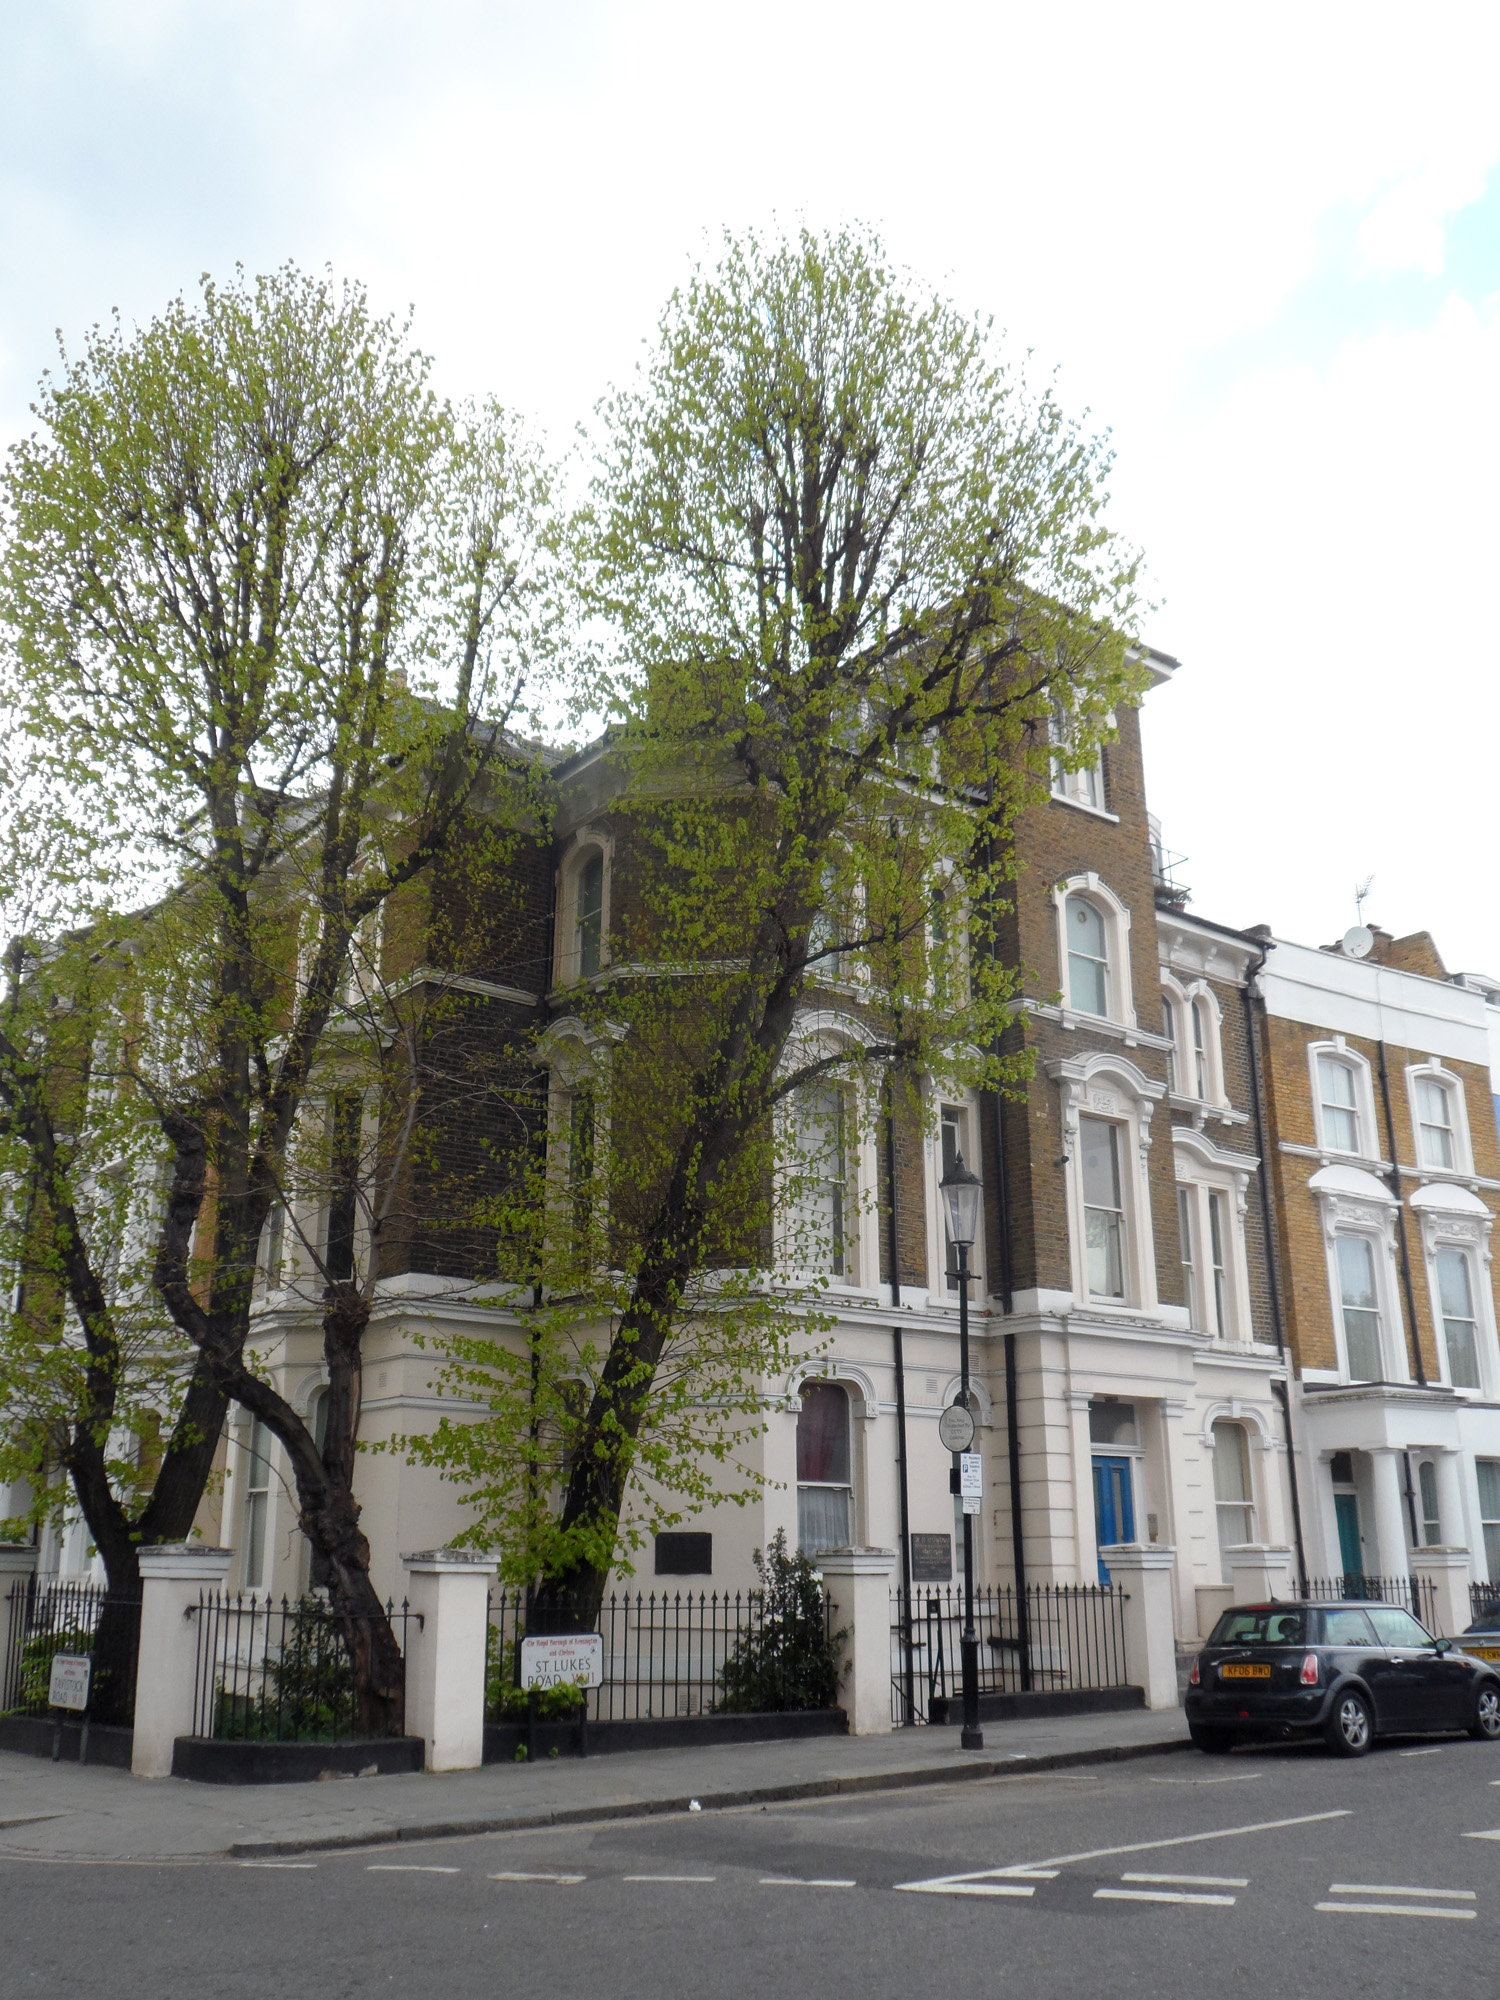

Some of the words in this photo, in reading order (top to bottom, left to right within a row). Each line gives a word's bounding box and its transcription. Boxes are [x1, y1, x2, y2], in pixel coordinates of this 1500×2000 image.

[537, 1640, 548, 1648] Royal
[550, 1639, 567, 1647] Borough
[575, 1638, 597, 1646] Kensington
[554, 1656, 591, 1672] LUKE'S
[1228, 1666, 1251, 1676] KF06
[55, 1677, 84, 1692] TAVISTOCK
[528, 1674, 562, 1688] ROAD
[52, 1690, 68, 1703] ROAD
